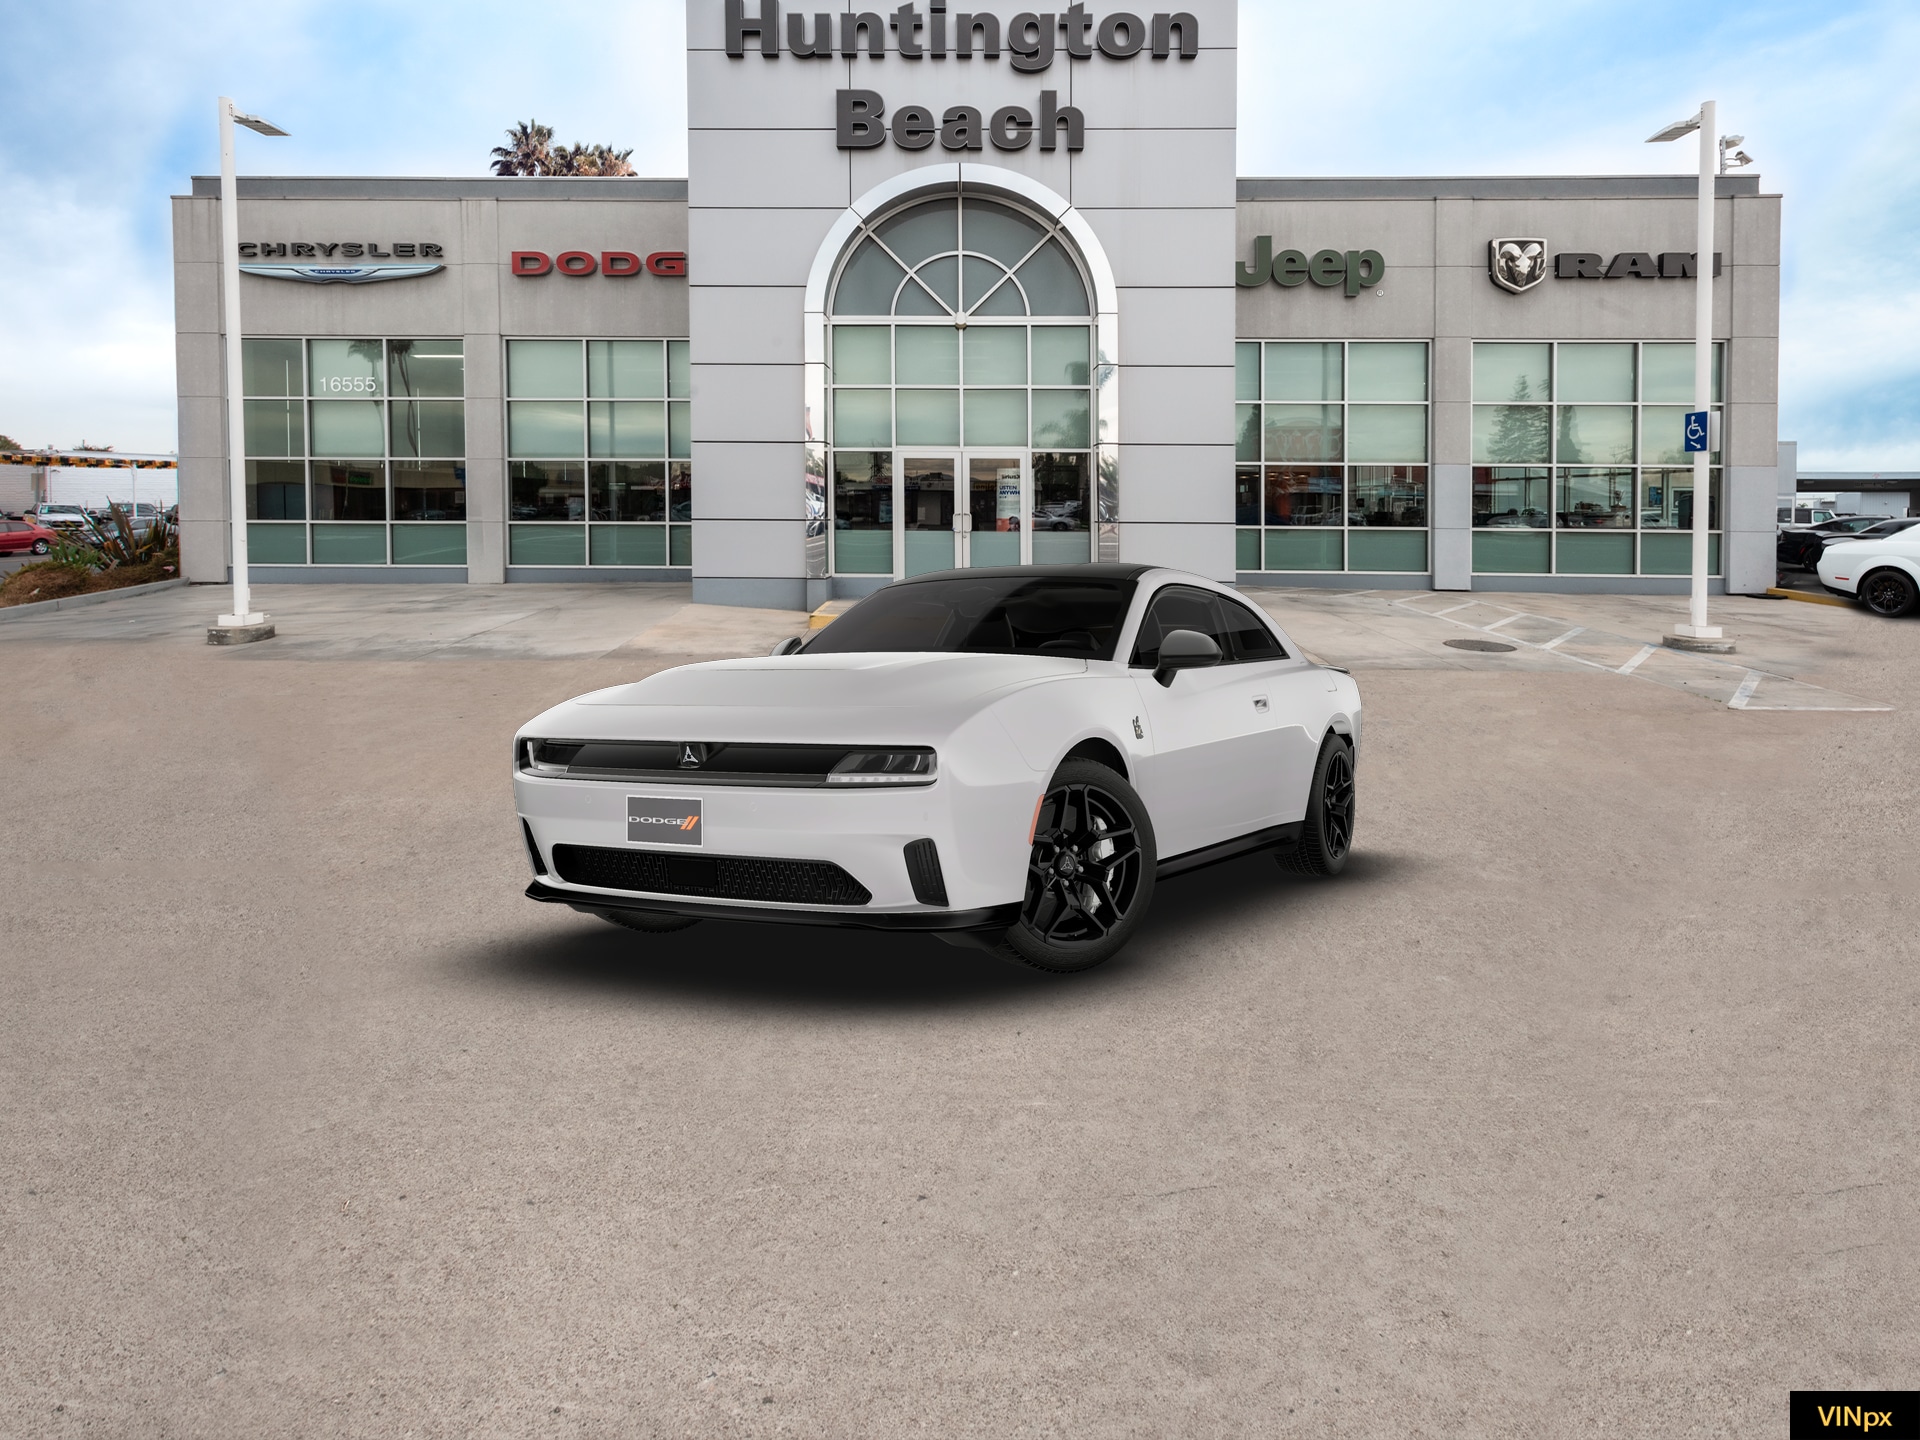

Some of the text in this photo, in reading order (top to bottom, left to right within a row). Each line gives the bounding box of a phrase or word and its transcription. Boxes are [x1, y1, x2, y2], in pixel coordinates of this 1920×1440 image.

[725, 0, 1200, 74] Huntington
[836, 89, 1085, 152] Beach
[238, 242, 444, 257] CHRYSLER
[511, 251, 687, 277] DODG
[1235, 234, 1385, 297] Jeep
[1555, 252, 1722, 279] RAM
[319, 377, 377, 392] 16555
[628, 816, 688, 825] DODGE
